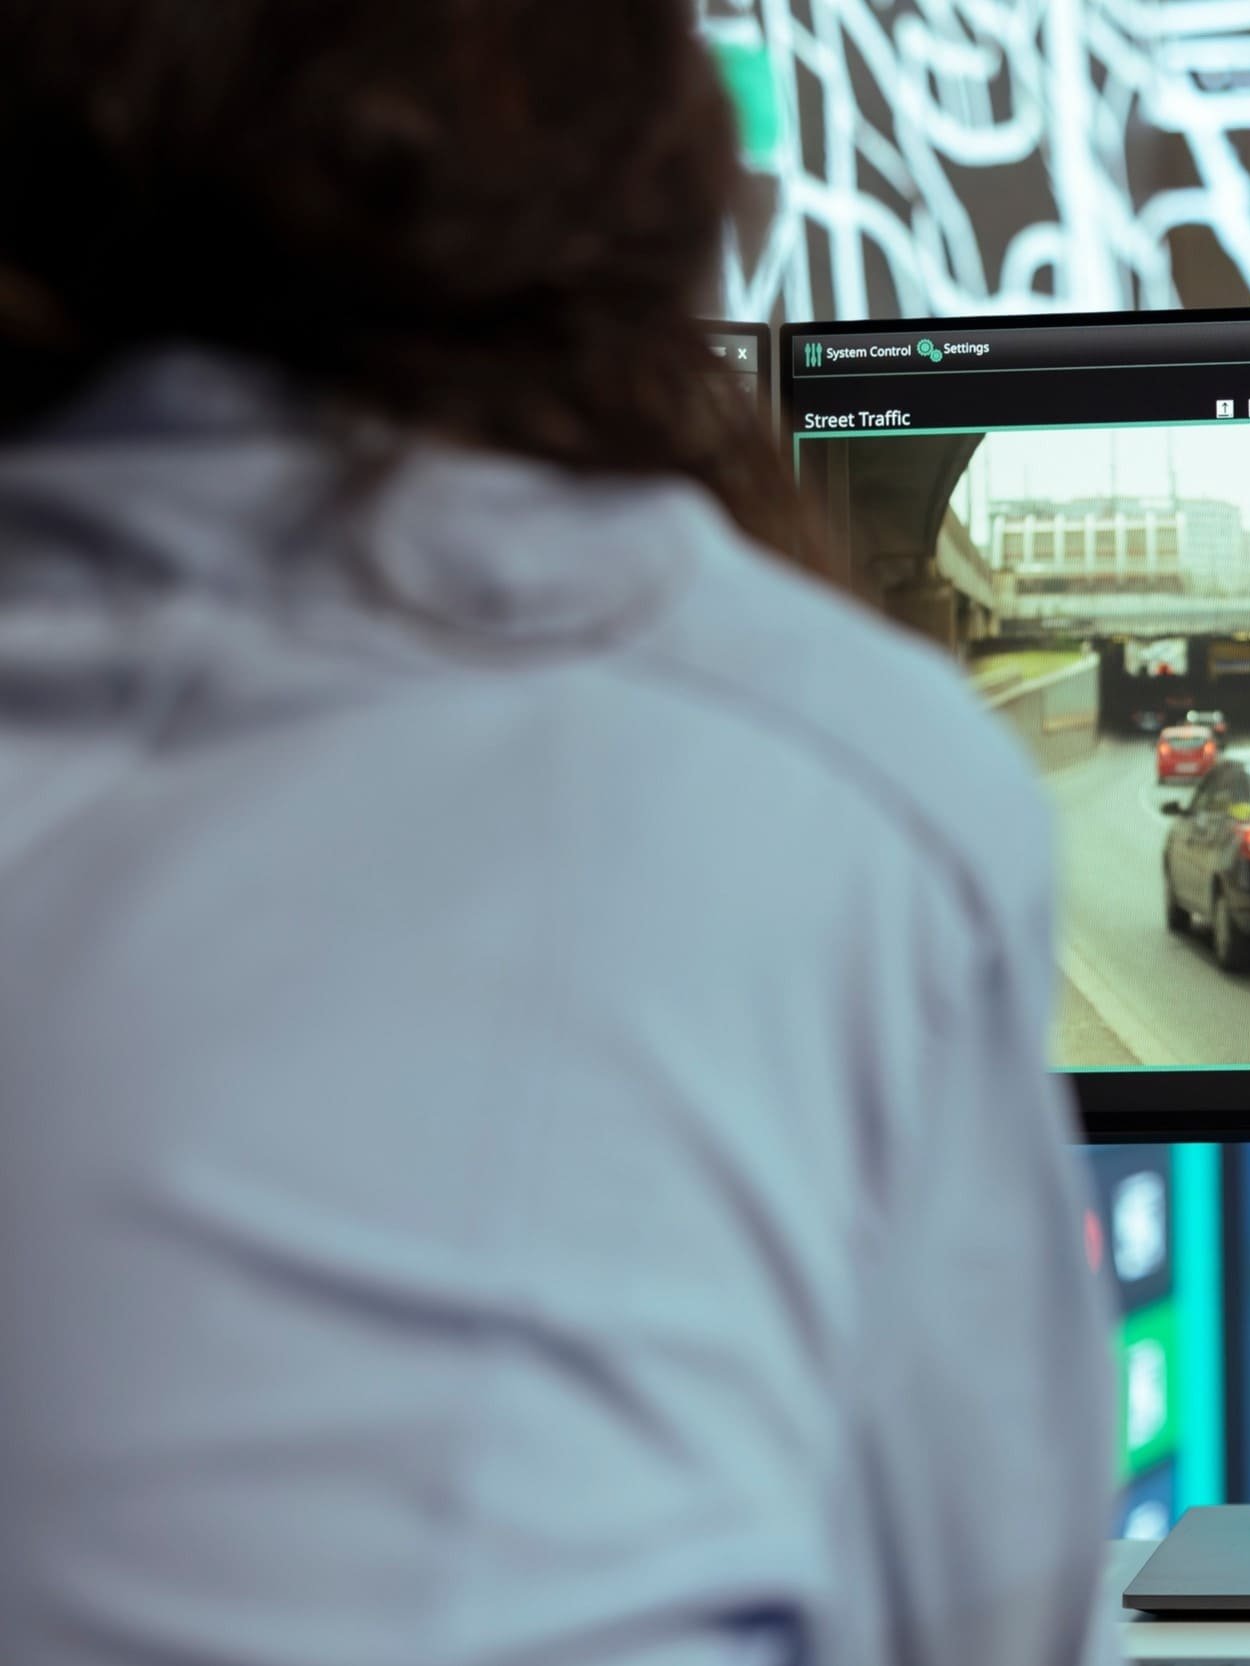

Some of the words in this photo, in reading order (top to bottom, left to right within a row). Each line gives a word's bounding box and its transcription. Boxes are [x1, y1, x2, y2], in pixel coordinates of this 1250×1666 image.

[826, 347, 867, 361] System
[869, 344, 912, 358] Control
[943, 342, 990, 355] Settings
[804, 413, 855, 428] Street
[858, 410, 911, 427] Traffic
